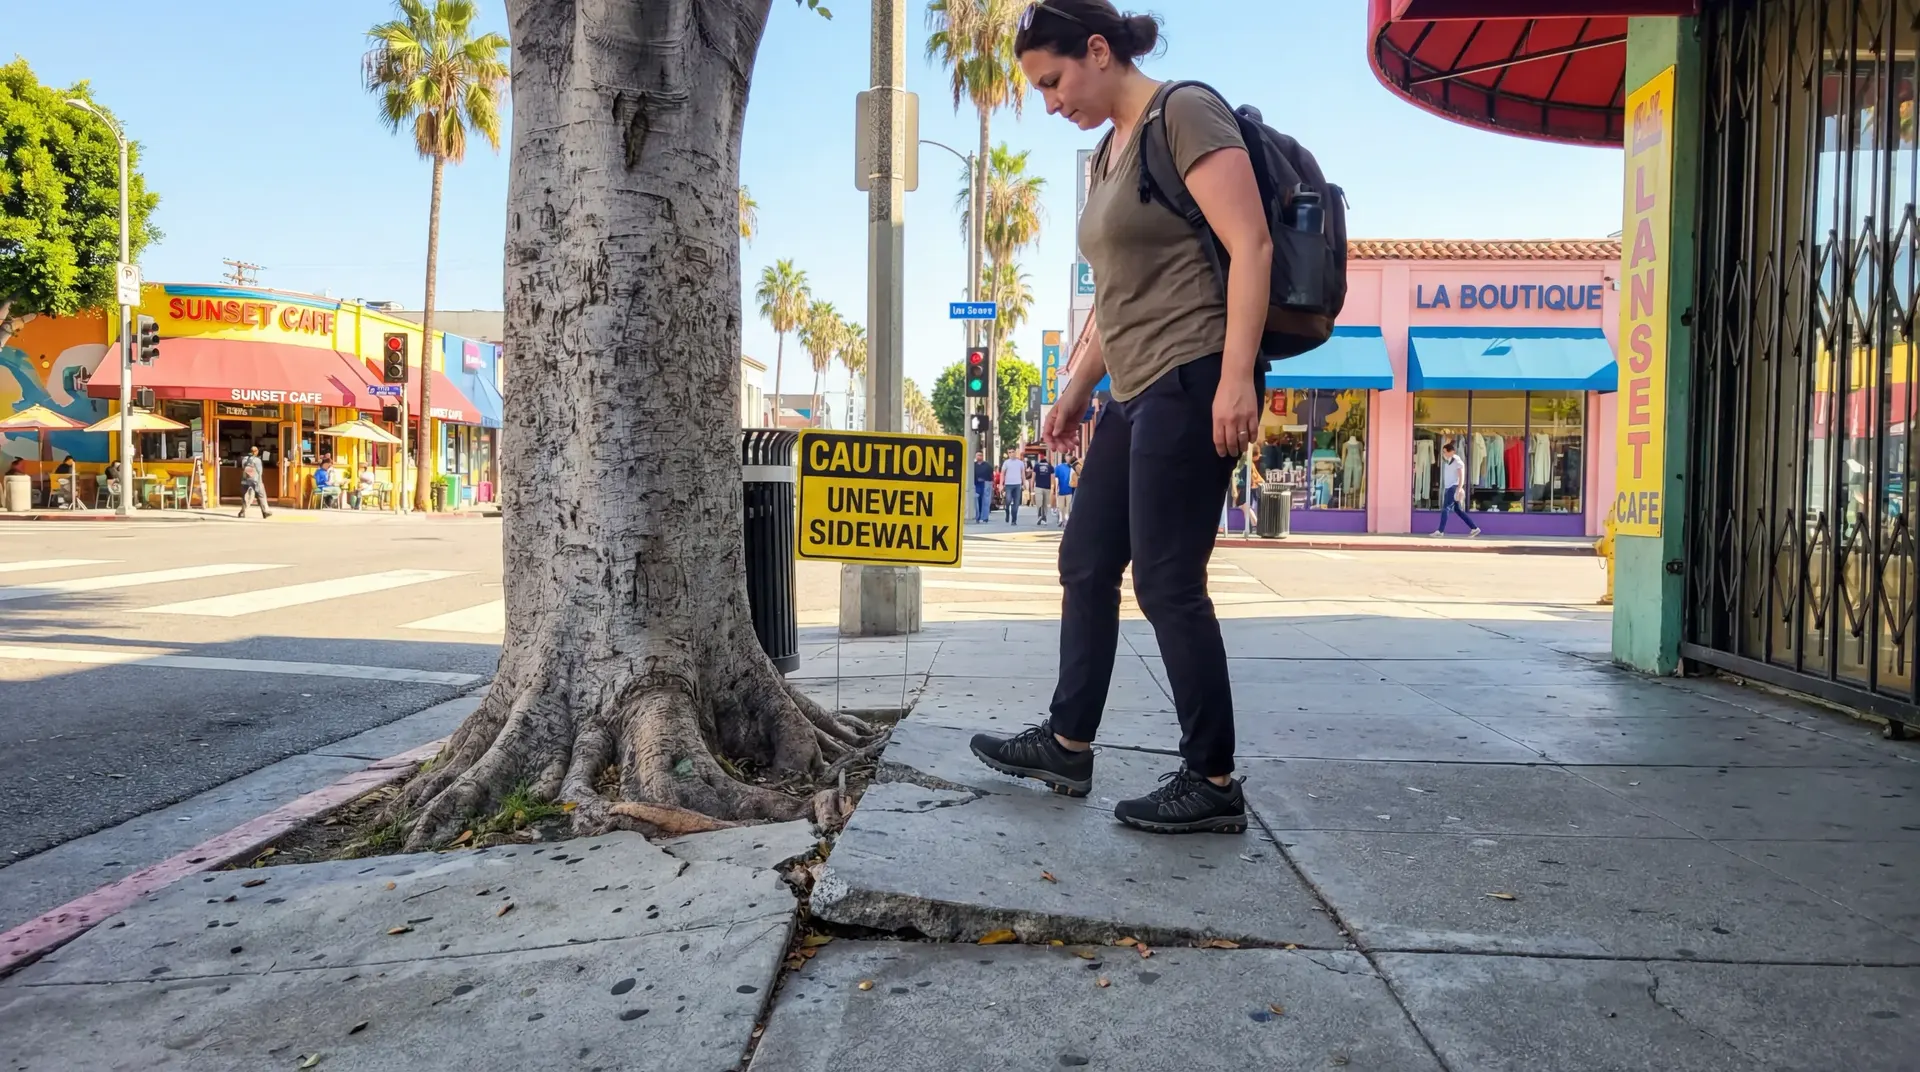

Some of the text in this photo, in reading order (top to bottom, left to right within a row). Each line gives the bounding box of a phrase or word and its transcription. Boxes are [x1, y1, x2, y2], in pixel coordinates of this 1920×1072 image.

[1416, 284, 1603, 311] LA BOUTIQUE
[169, 297, 334, 334] SUNSET CAFE
[1627, 166, 1657, 480] LANSET
[231, 388, 322, 404] SUNSET CAFE
[809, 439, 955, 477] CAUTION:
[827, 486, 933, 517] UNEVEN
[1616, 491, 1659, 525] CAFE
[809, 519, 950, 551] SIDEWALK
